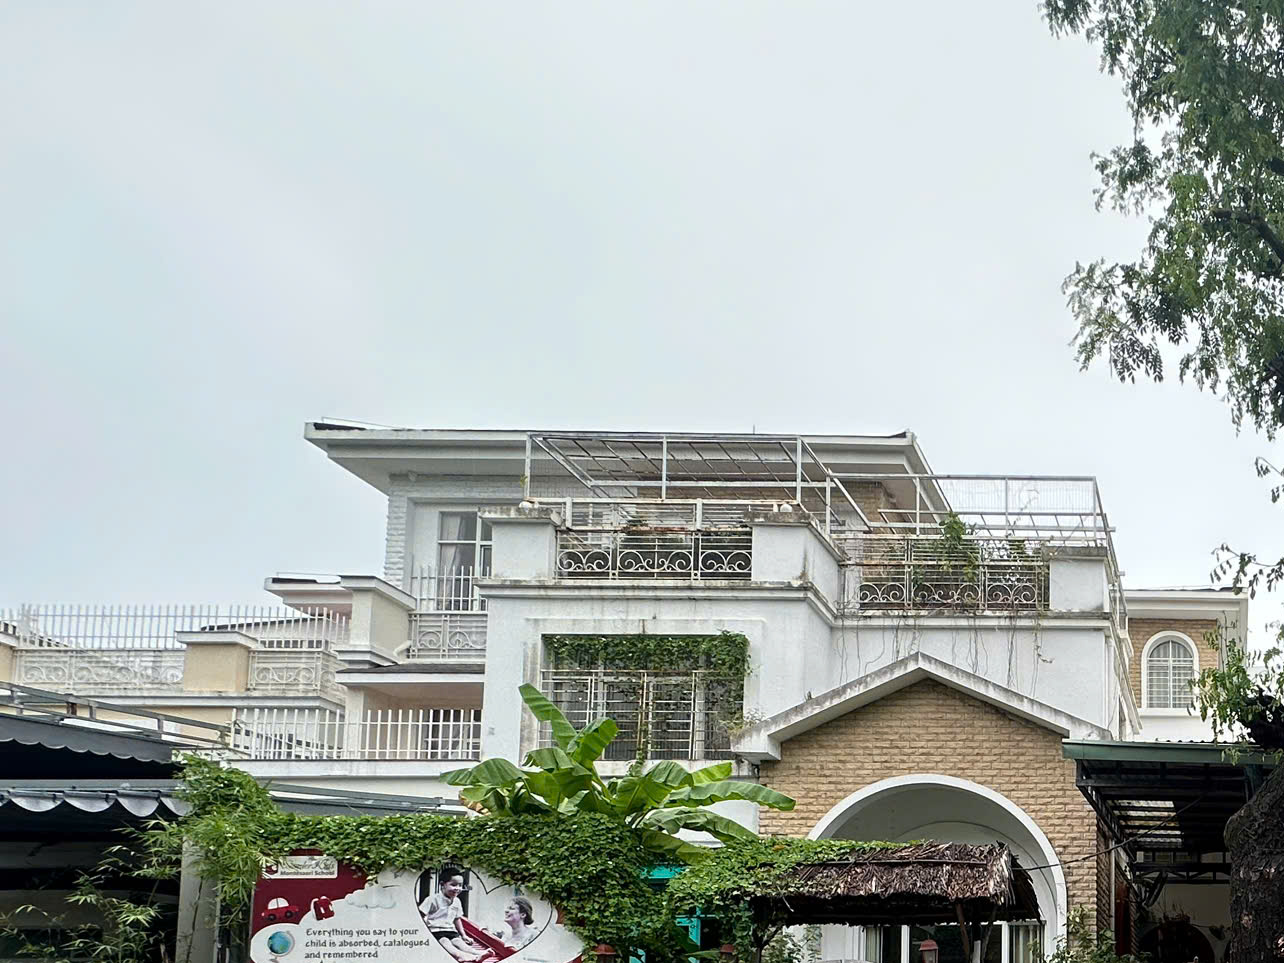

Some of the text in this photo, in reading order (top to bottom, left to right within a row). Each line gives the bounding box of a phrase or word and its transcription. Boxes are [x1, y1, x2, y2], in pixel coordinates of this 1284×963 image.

[306, 928, 419, 938] Everything you say to your
[305, 939, 430, 949] child is absorbed, catalogued
[304, 951, 379, 959] and remembered
